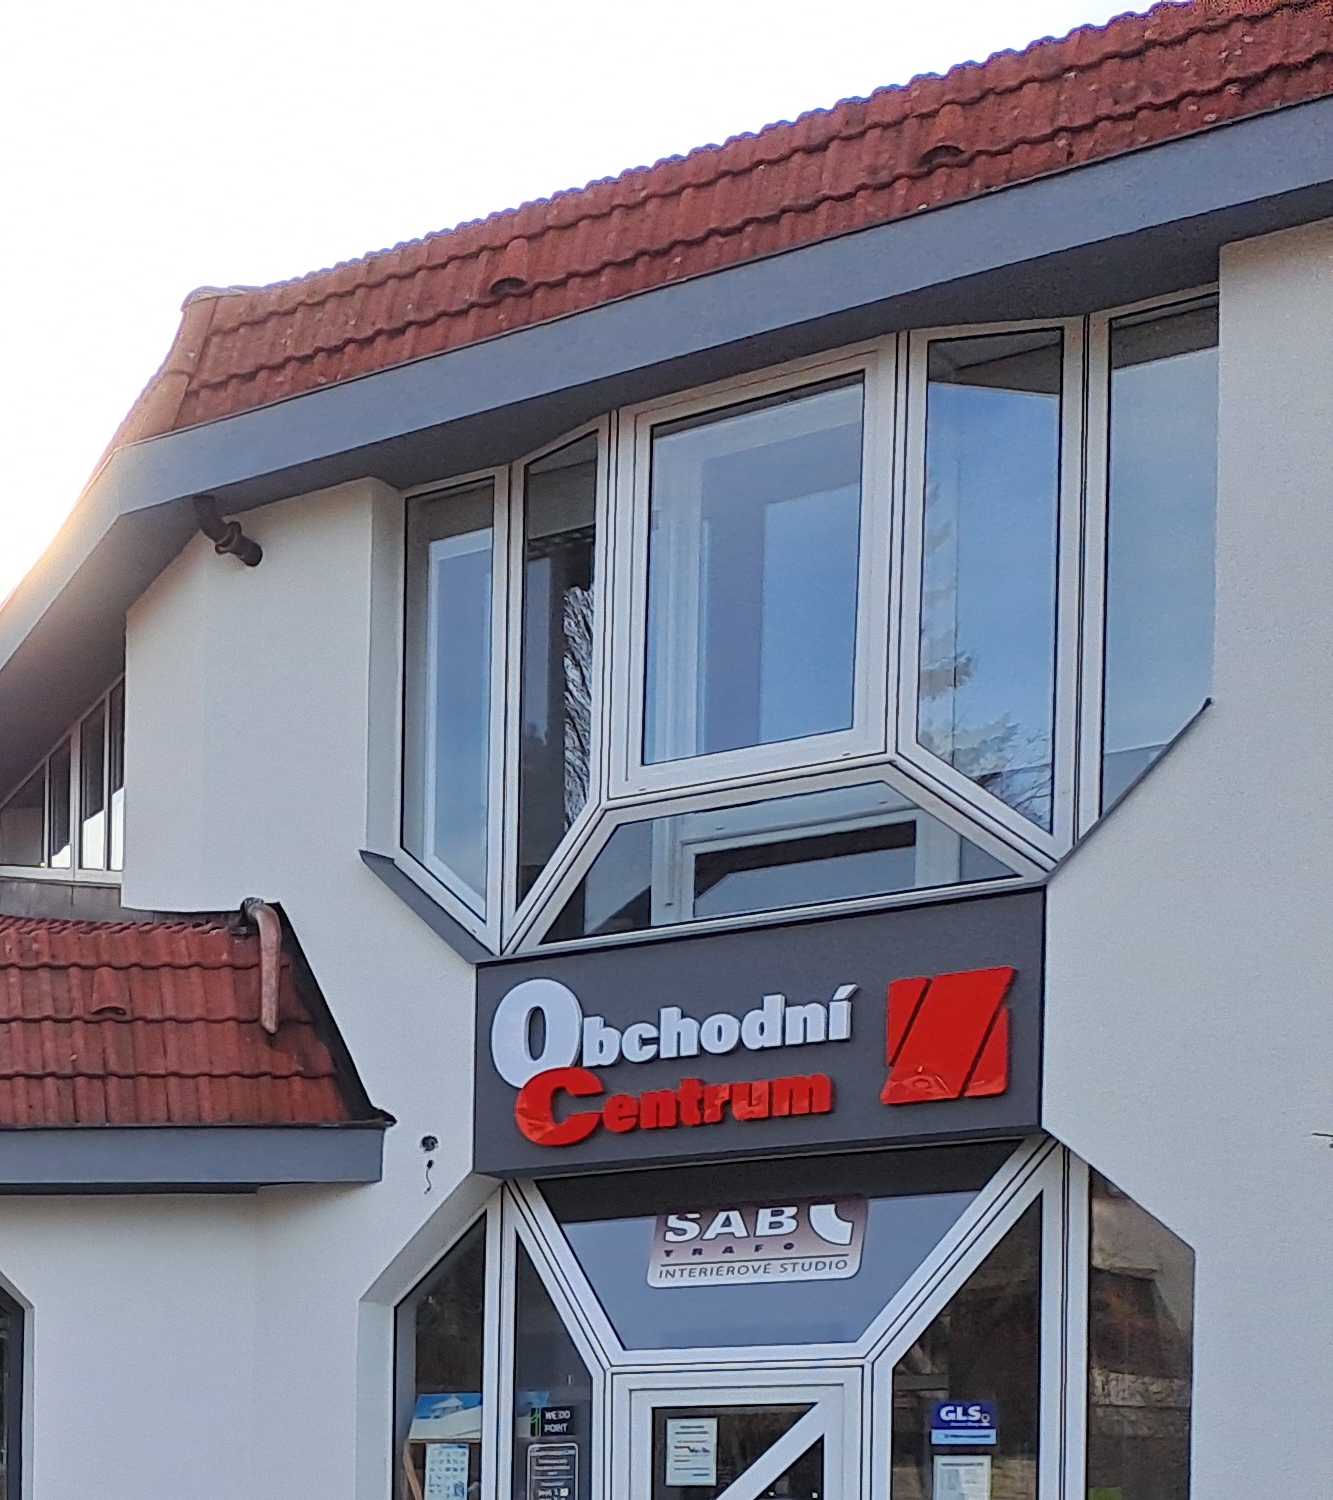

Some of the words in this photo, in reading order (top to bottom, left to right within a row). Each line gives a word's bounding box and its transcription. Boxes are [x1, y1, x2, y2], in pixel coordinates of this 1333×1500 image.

[491, 978, 859, 1088] Obchodní
[515, 1066, 833, 1147] Centrum
[663, 1206, 800, 1243] SAB
[658, 1262, 771, 1280] INTERIÉROVÉ
[779, 1259, 848, 1274] STUDIO
[939, 1405, 982, 1421] GLS
